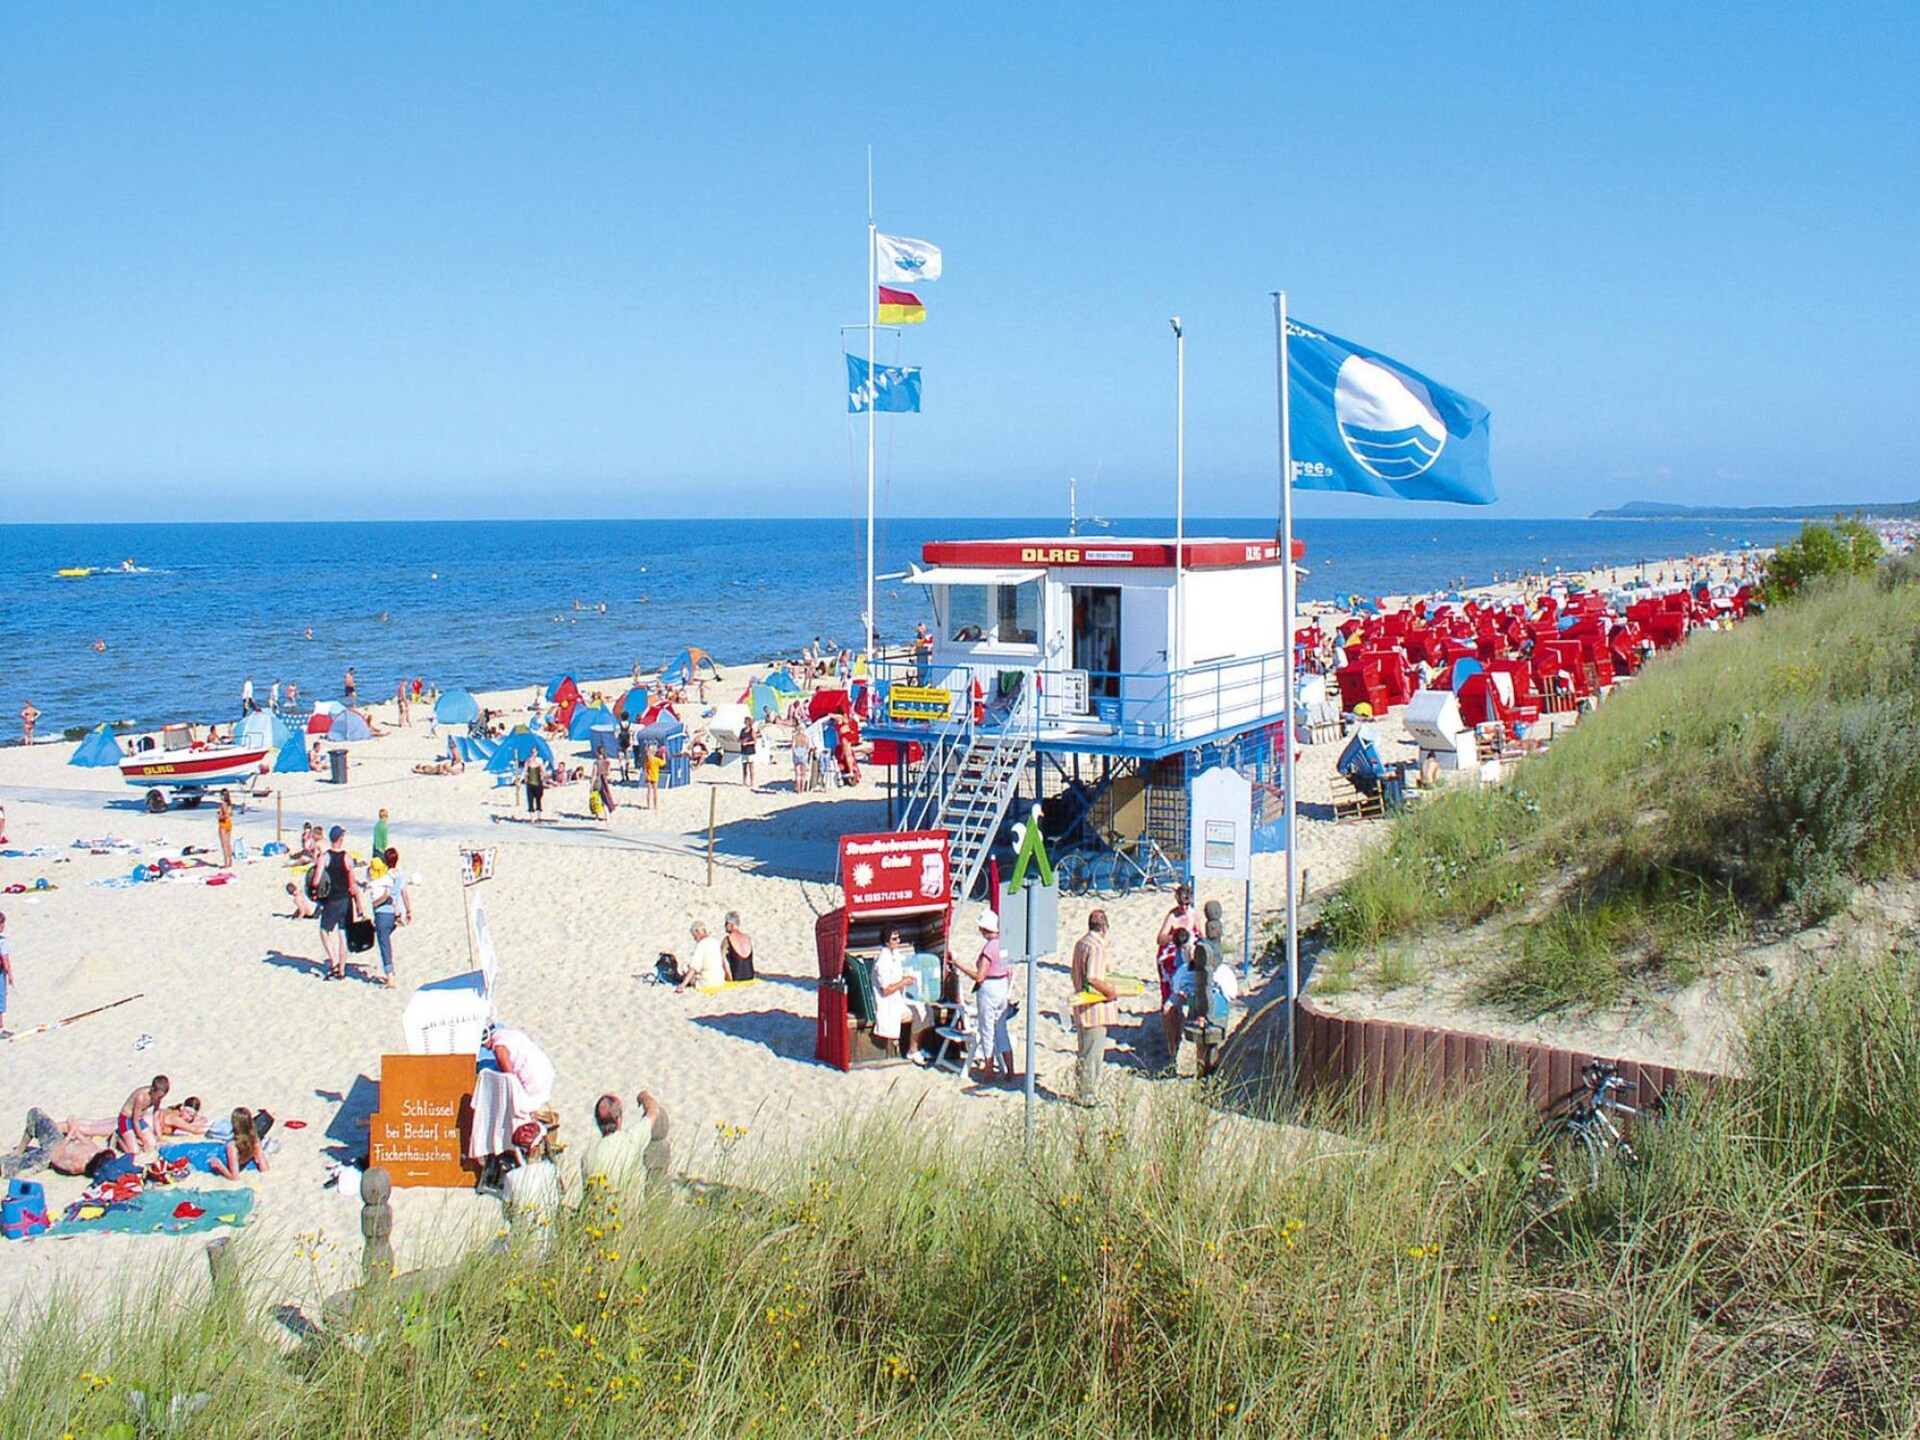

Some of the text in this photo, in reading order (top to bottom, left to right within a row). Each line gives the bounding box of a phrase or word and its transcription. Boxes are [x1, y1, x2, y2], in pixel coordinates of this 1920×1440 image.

[1021, 548, 1080, 562] DLRG
[143, 764, 175, 775] DLRG
[401, 1099, 454, 1117] Schlüssel
[385, 1122, 457, 1141] bei Bedarf im
[373, 1143, 452, 1162] Fischerhäuschen
